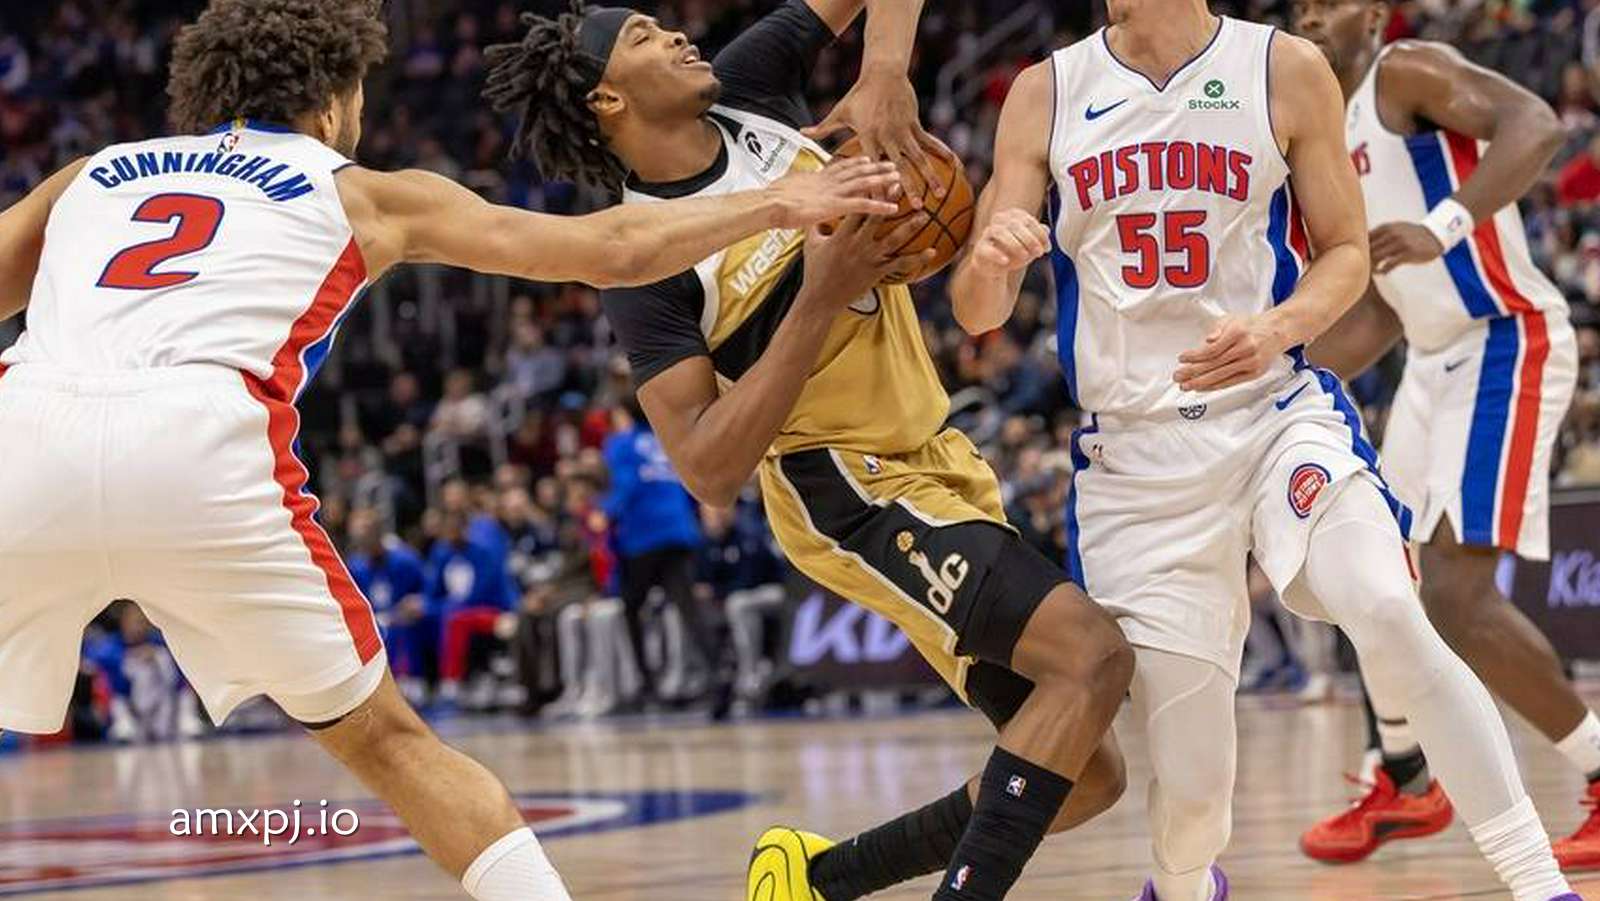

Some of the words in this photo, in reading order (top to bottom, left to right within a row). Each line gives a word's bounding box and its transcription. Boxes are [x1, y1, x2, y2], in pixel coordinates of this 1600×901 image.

[1188, 99, 1240, 110] StockX
[89, 152, 314, 202] CUNNINGHAM
[1067, 140, 1253, 211] PISTONS
[96, 192, 225, 290] 2
[1116, 210, 1210, 289] 55
